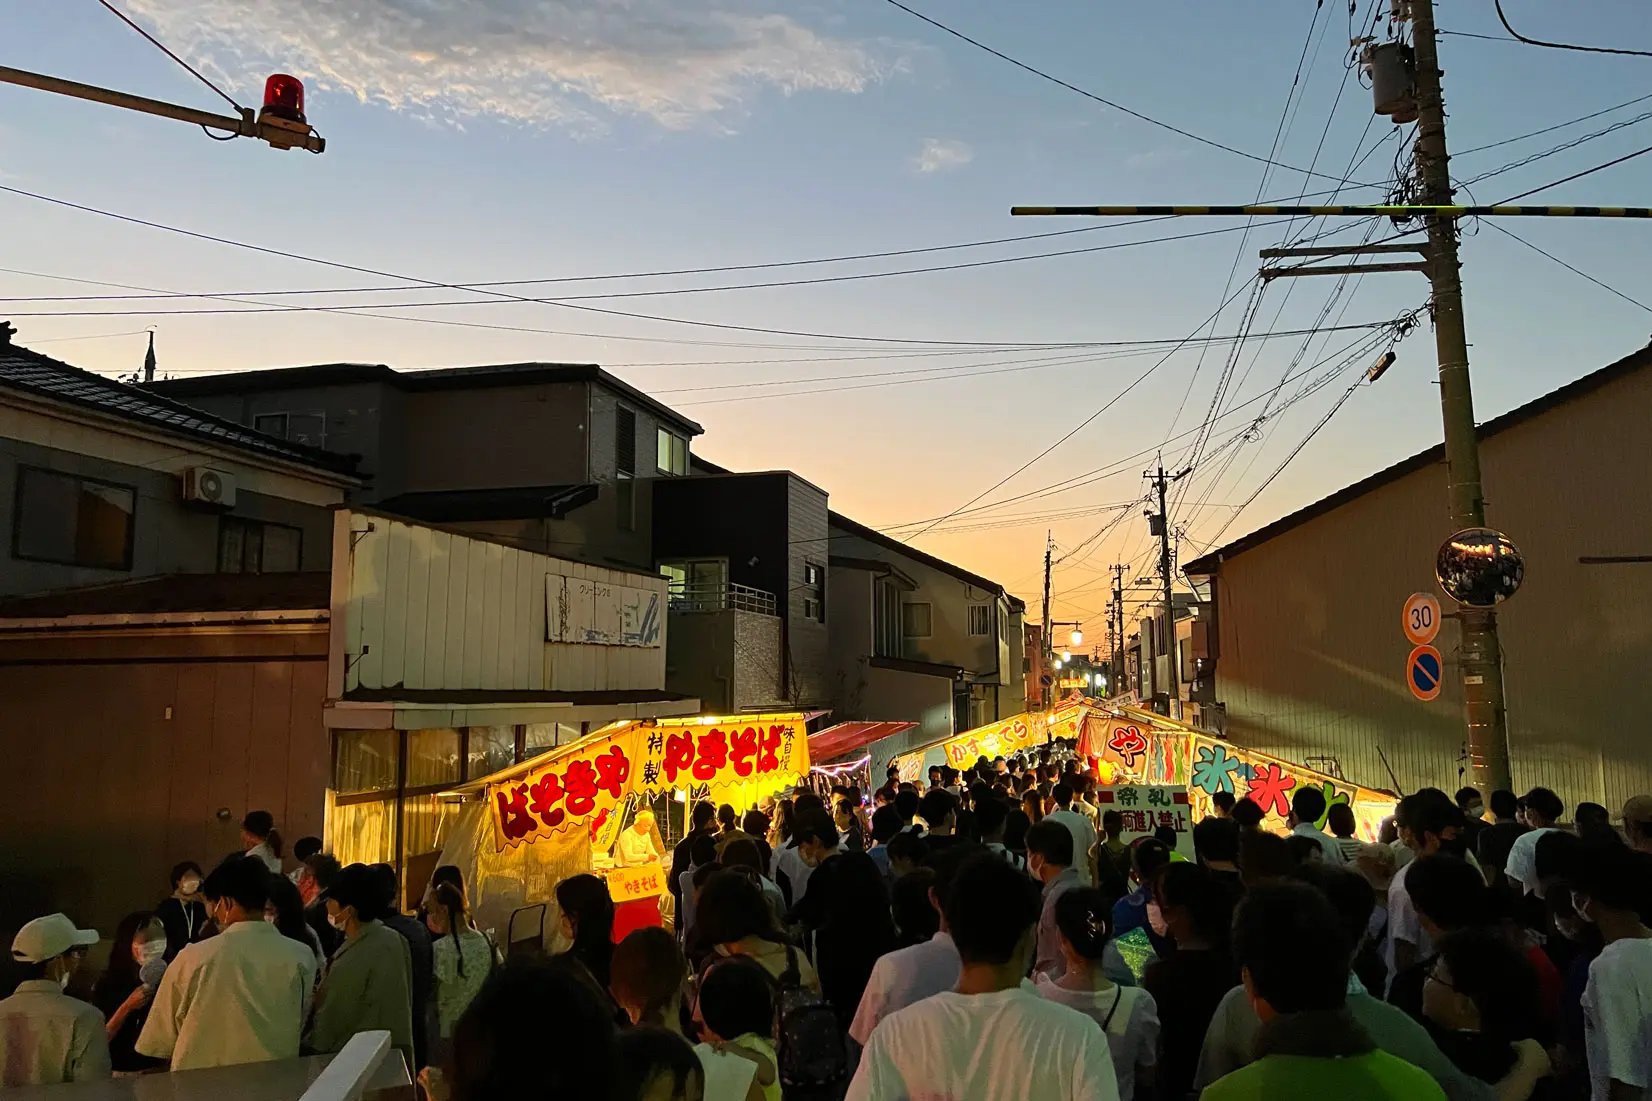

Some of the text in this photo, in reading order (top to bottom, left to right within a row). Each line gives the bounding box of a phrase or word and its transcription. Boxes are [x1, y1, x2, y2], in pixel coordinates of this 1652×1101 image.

[1411, 605, 1432, 630] 30
[642, 731, 664, 785] 特製
[662, 724, 785, 783] やきそば
[1192, 744, 1241, 795] 氷
[1246, 762, 1297, 817] 氷
[624, 872, 659, 894] やきそば
